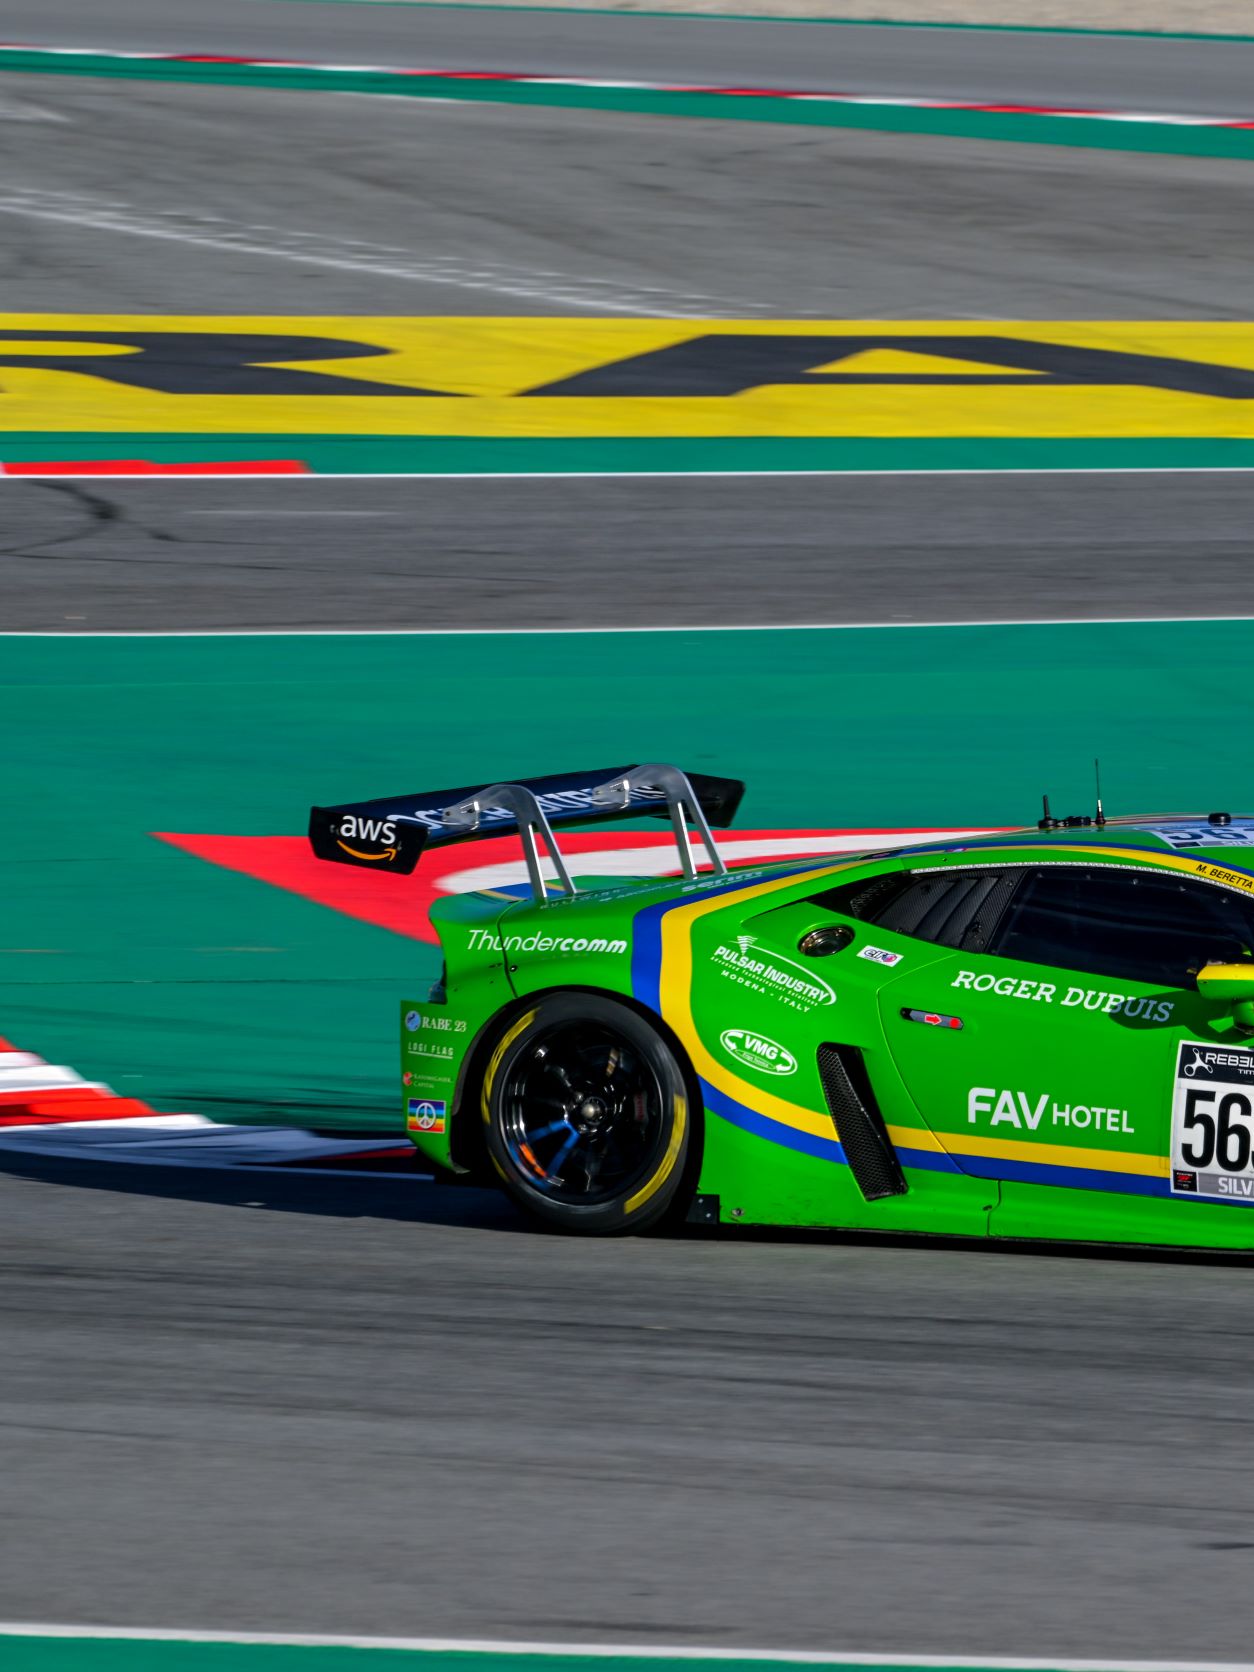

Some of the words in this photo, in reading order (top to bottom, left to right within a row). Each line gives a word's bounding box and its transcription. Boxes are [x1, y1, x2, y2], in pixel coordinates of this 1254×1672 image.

[339, 815, 397, 845] aws
[1195, 863, 1207, 874] M.
[1209, 867, 1253, 889] BERETTA
[466, 929, 628, 954] Thundercomm
[714, 946, 766, 975] PULSAR
[762, 965, 831, 1002] INDUSTRY
[721, 970, 766, 994] MODENA
[778, 995, 811, 1013] ITALY
[951, 970, 1057, 1003] ROGER
[1060, 986, 1175, 1023] DUBUIS
[422, 1016, 452, 1031] RABE
[454, 1020, 467, 1032] 23
[408, 1041, 427, 1052] LOGI
[744, 1035, 779, 1060] VMG
[967, 1086, 1050, 1130] FAV
[1052, 1102, 1135, 1133] HOTEL
